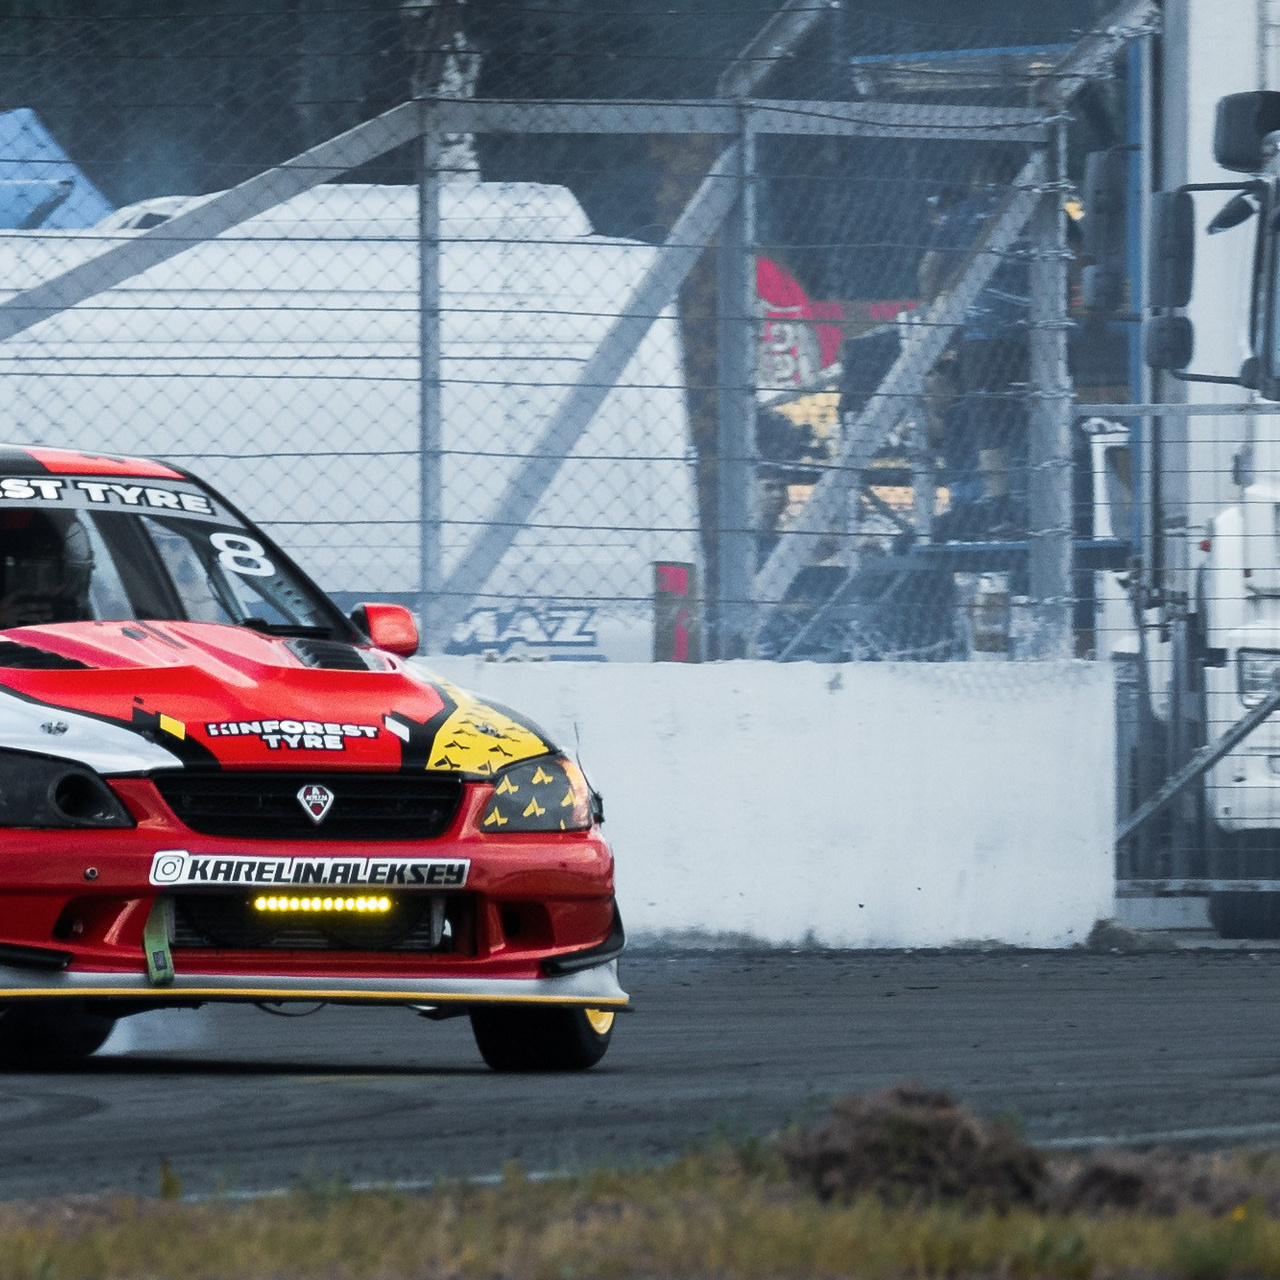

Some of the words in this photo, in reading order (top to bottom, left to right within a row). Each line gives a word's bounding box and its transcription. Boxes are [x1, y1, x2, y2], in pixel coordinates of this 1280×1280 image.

[77, 482, 212, 514] TYRE
[210, 532, 276, 577] 8
[207, 720, 378, 739] KINFOREST
[262, 734, 343, 750] TYRE
[187, 857, 468, 886] KARELIN.ALEKSEY
